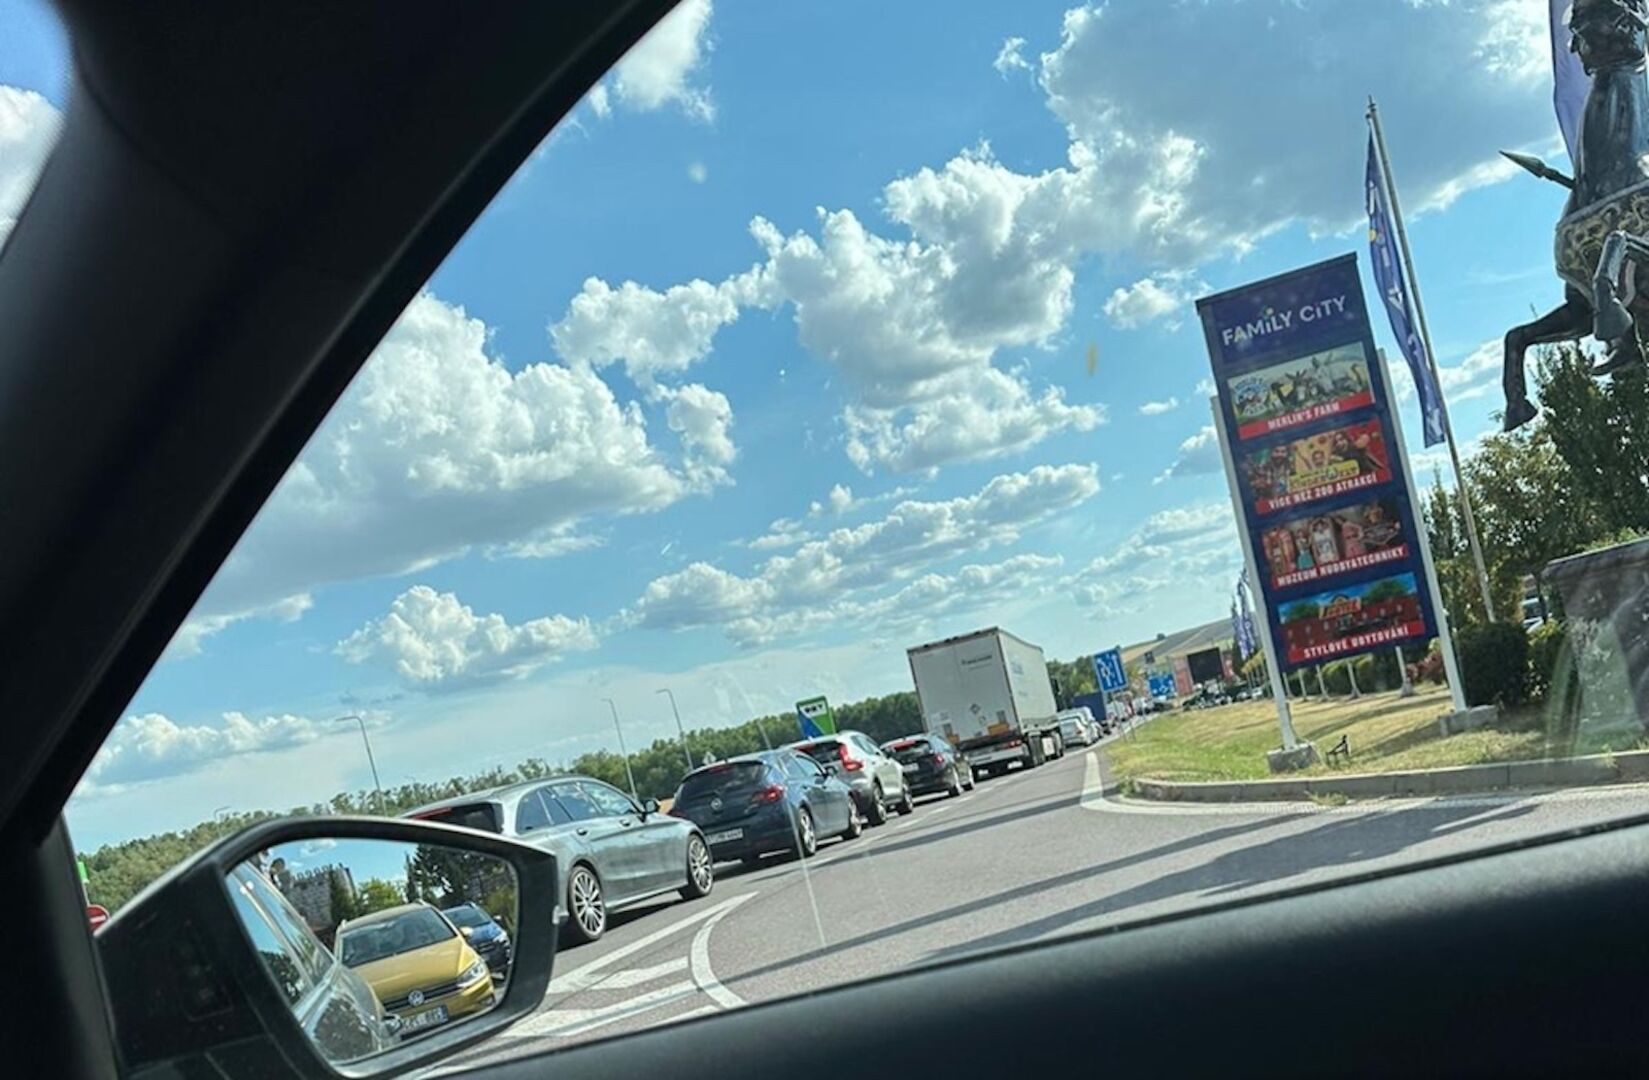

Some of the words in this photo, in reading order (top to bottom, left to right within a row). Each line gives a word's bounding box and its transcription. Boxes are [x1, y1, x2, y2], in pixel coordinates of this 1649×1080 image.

[1267, 410, 1313, 430] MERLIN'S
[1313, 402, 1342, 419] FARM
[1335, 472, 1378, 494] ATRAKCÍ
[1276, 567, 1319, 587] MUZEUM
[1303, 638, 1350, 659] STYLOVÉ
[1350, 625, 1409, 647] UBYTOVÁNÍ
